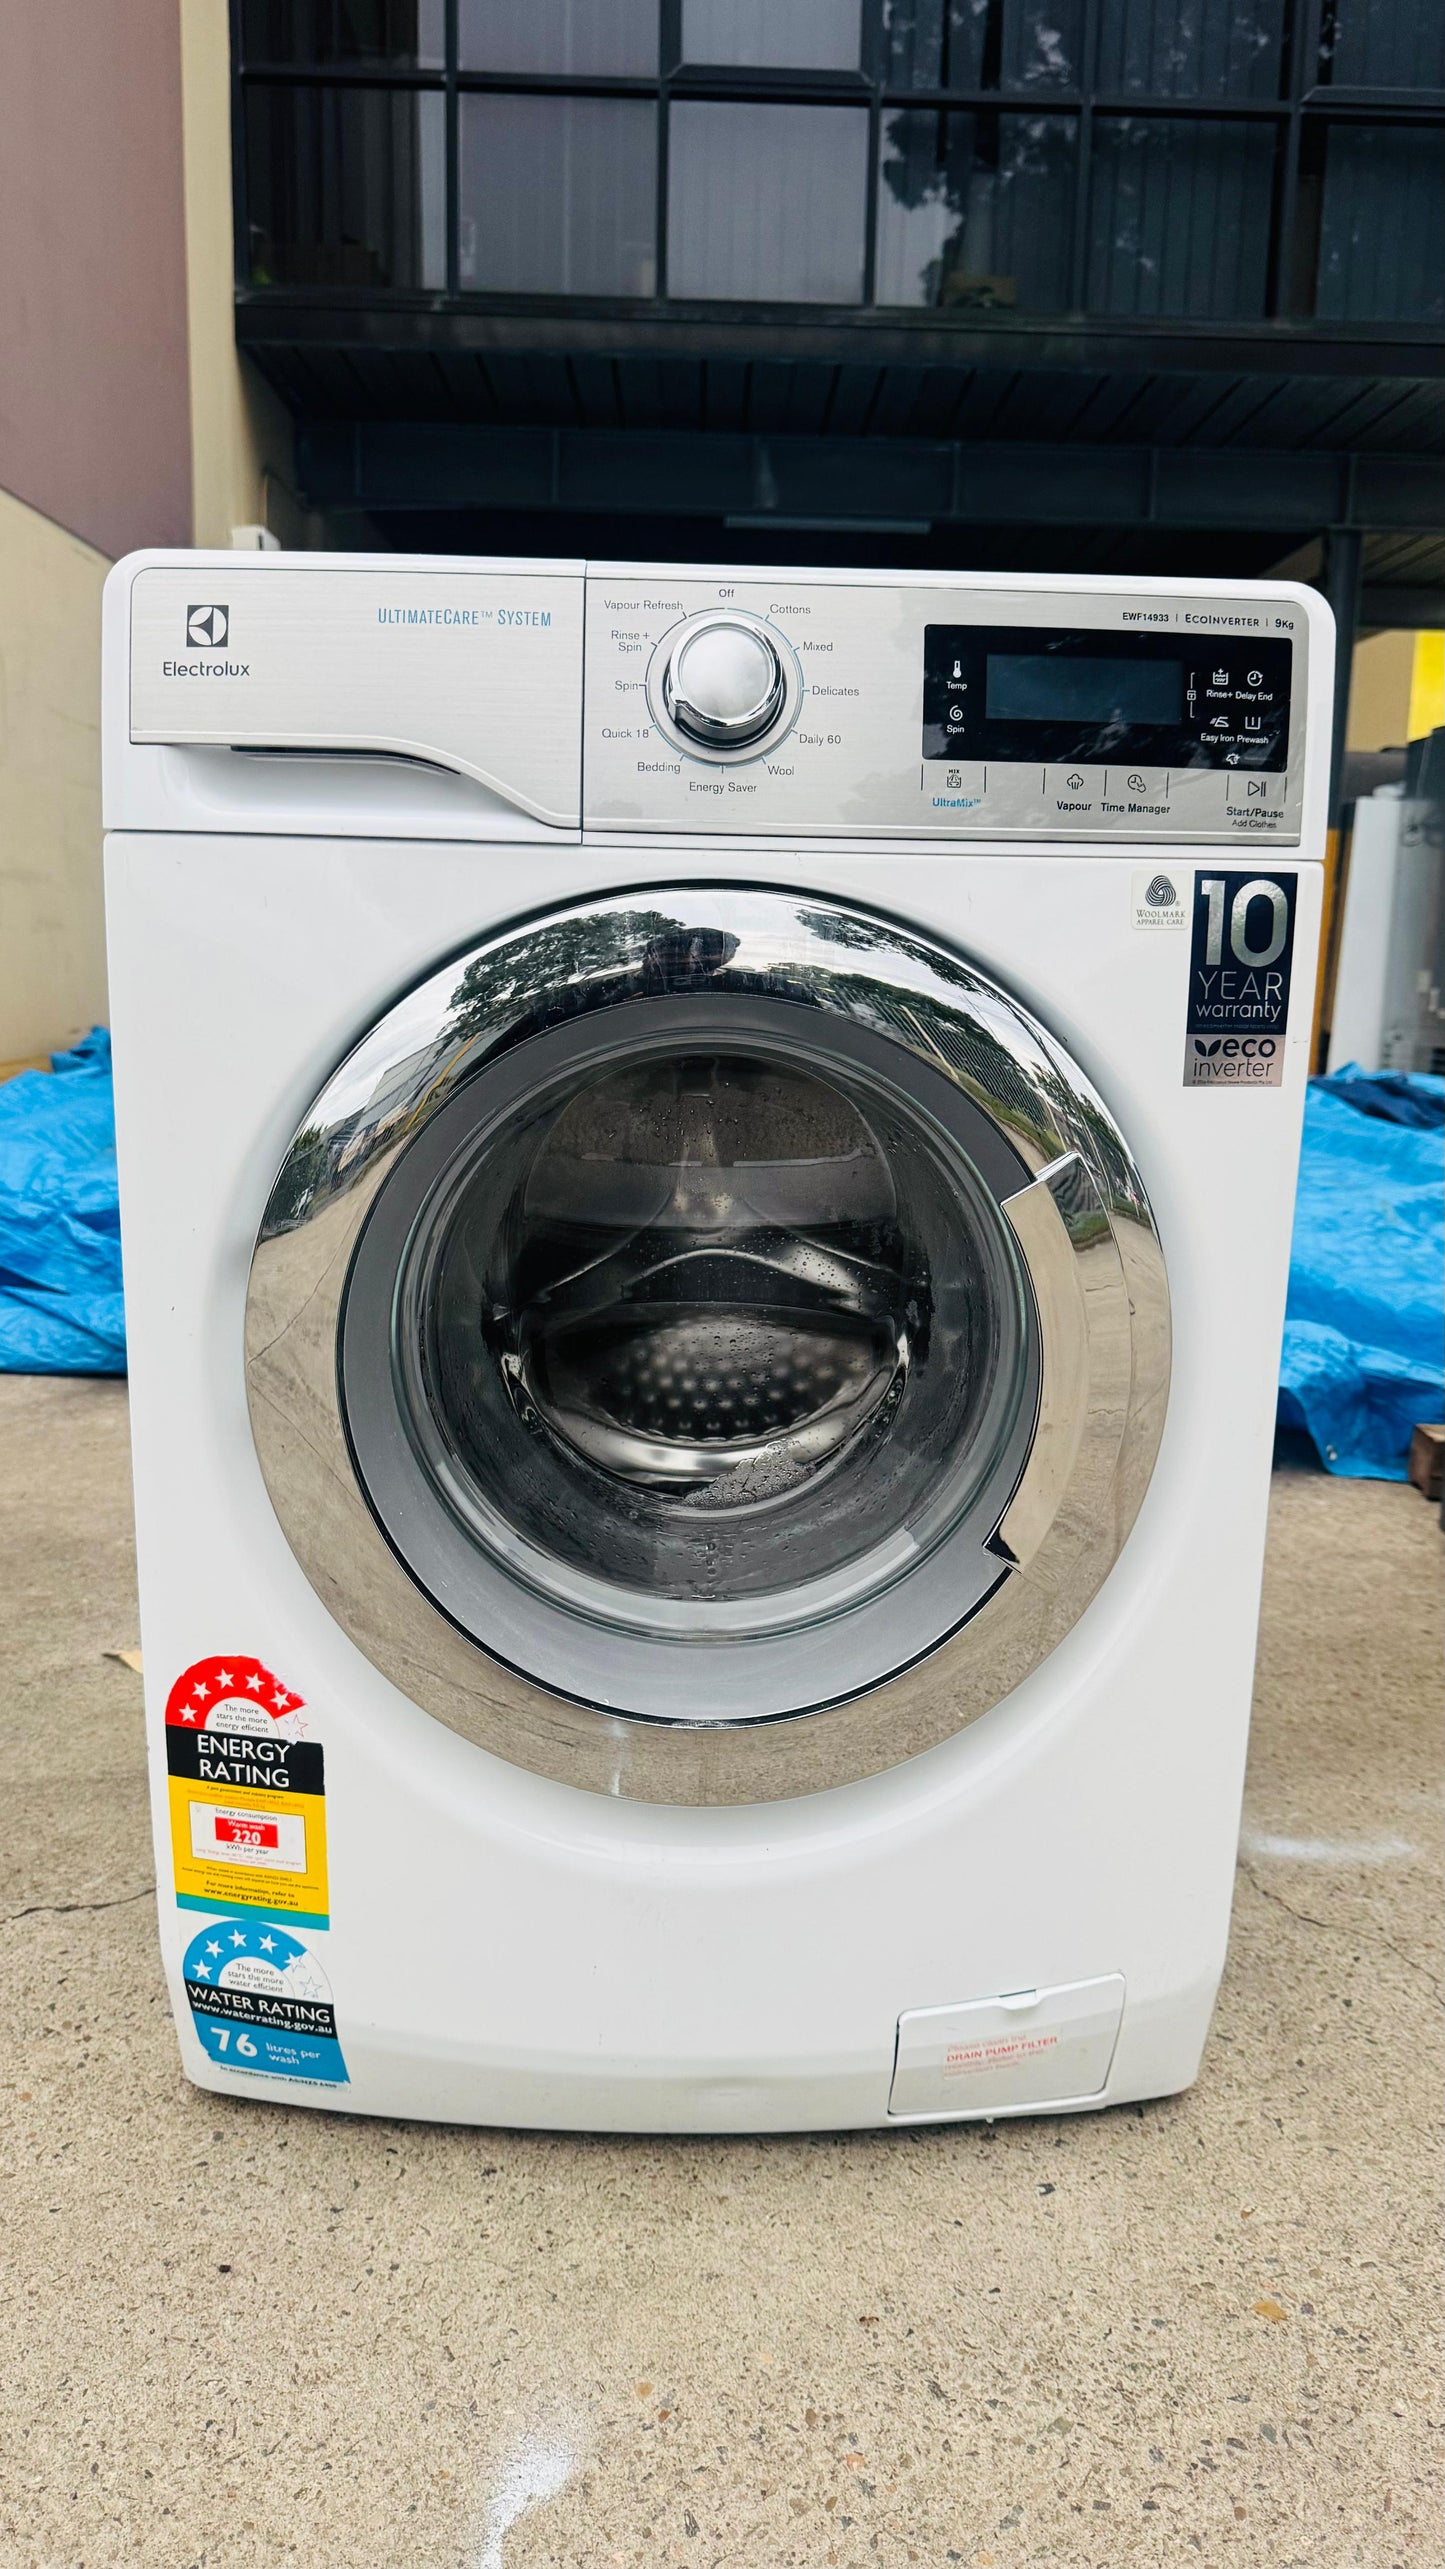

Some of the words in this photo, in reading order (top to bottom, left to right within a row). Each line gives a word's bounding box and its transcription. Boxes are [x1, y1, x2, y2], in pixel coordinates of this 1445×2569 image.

[719, 588, 735, 598] Off
[604, 600, 639, 611] Vapour
[643, 600, 684, 611] Refresh
[769, 603, 811, 614] Cottons
[1122, 612, 1169, 622] EWF14933
[611, 630, 640, 640] Rinse
[618, 641, 642, 654] Spin
[803, 641, 833, 652] Mixed
[163, 661, 250, 678] Electrolux
[615, 680, 639, 693] Spin
[812, 685, 860, 697] Delicates
[946, 681, 968, 691] Temp
[1206, 689, 1233, 699] Rinse+
[1235, 690, 1257, 702] Delay
[1258, 692, 1273, 701] End
[601, 728, 632, 740] Quick
[636, 728, 650, 739] 18
[946, 724, 965, 735] Spin
[799, 734, 824, 745] Daily
[827, 735, 842, 745] 60
[1200, 733, 1219, 744] Easy
[1220, 734, 1235, 742] Iron
[1237, 734, 1270, 744] Prewash
[637, 761, 681, 774] Bedding
[767, 765, 795, 776] Wool
[689, 782, 725, 795] Energy
[727, 782, 757, 794] Saver
[1056, 800, 1092, 812] Vapour
[1101, 802, 1125, 813] Time
[1127, 803, 1171, 815] Manager
[1226, 806, 1284, 819] Start/Pause
[1232, 819, 1248, 828] Add
[1249, 820, 1277, 829] Clothes
[1136, 909, 1186, 918] WOOLMARK
[1201, 879, 1288, 968] 10
[1198, 971, 1283, 1001] YEAR
[1196, 1000, 1282, 1023] warranty
[1222, 1038, 1276, 1058] eco
[1193, 1058, 1274, 1077] inverter
[224, 1704, 238, 1712] The
[239, 1707, 260, 1715] more
[216, 1713, 233, 1721] stars
[235, 1714, 247, 1722] the
[248, 1717, 268, 1725] more
[216, 1722, 240, 1731] energy
[241, 1724, 270, 1734] efficient
[197, 1734, 290, 1763] ENERGY
[199, 1758, 290, 1788] RATING
[232, 1828, 262, 1845] 220
[236, 1963, 252, 1972] The
[253, 1967, 275, 1976] more
[228, 1970, 246, 1980] stars
[248, 1973, 260, 1981] the
[262, 1977, 284, 1985] more
[229, 1978, 251, 1987] water
[253, 1982, 284, 1993] efficient
[188, 1983, 253, 2012] WATER
[258, 1999, 331, 2024] RATING
[192, 2000, 333, 2034] www.waterrating.gov.au
[210, 2026, 258, 2058] 76
[265, 2042, 297, 2056] litres
[300, 2050, 321, 2060] per
[946, 2050, 982, 2063] DRAIN
[985, 2043, 1019, 2057] PUMP
[1021, 2036, 1058, 2050] FILTER
[269, 2053, 300, 2065] wash
